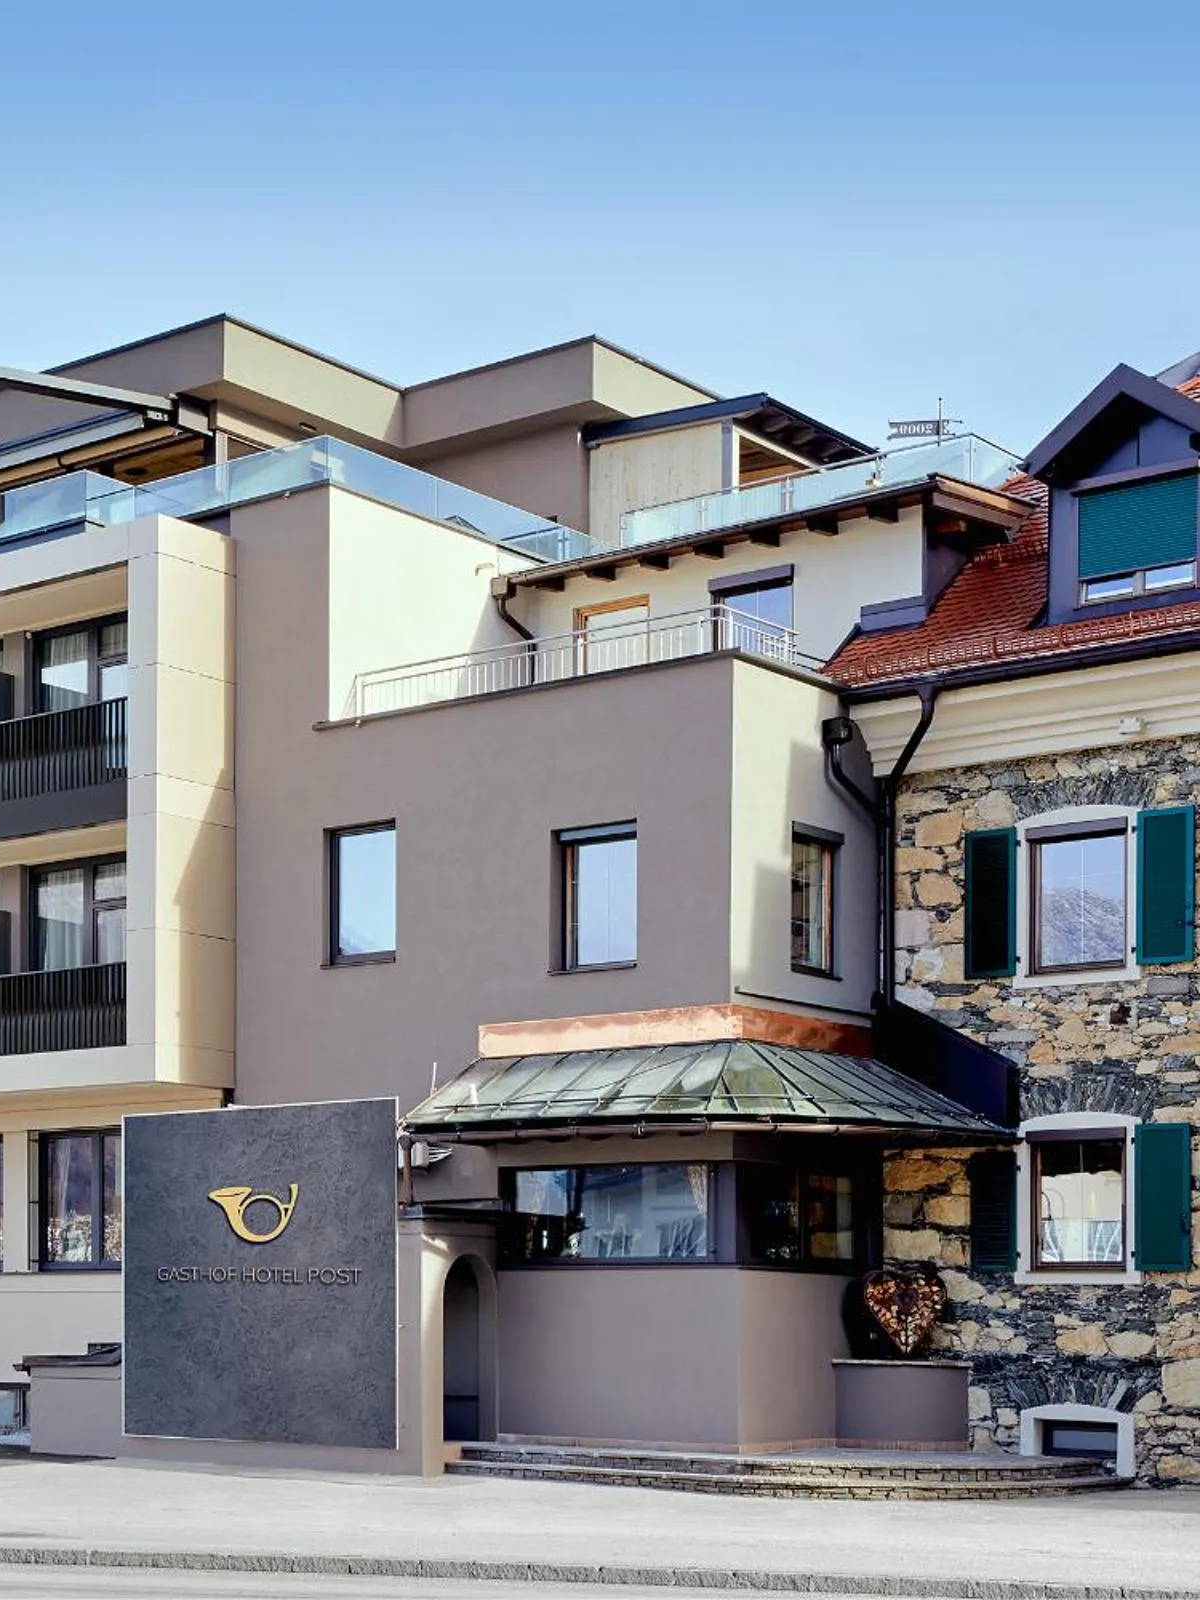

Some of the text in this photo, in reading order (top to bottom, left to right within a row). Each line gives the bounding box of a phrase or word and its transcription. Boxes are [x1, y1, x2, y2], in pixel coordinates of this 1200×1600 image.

[157, 1265, 363, 1286] GASTHOF HOTEL POST
